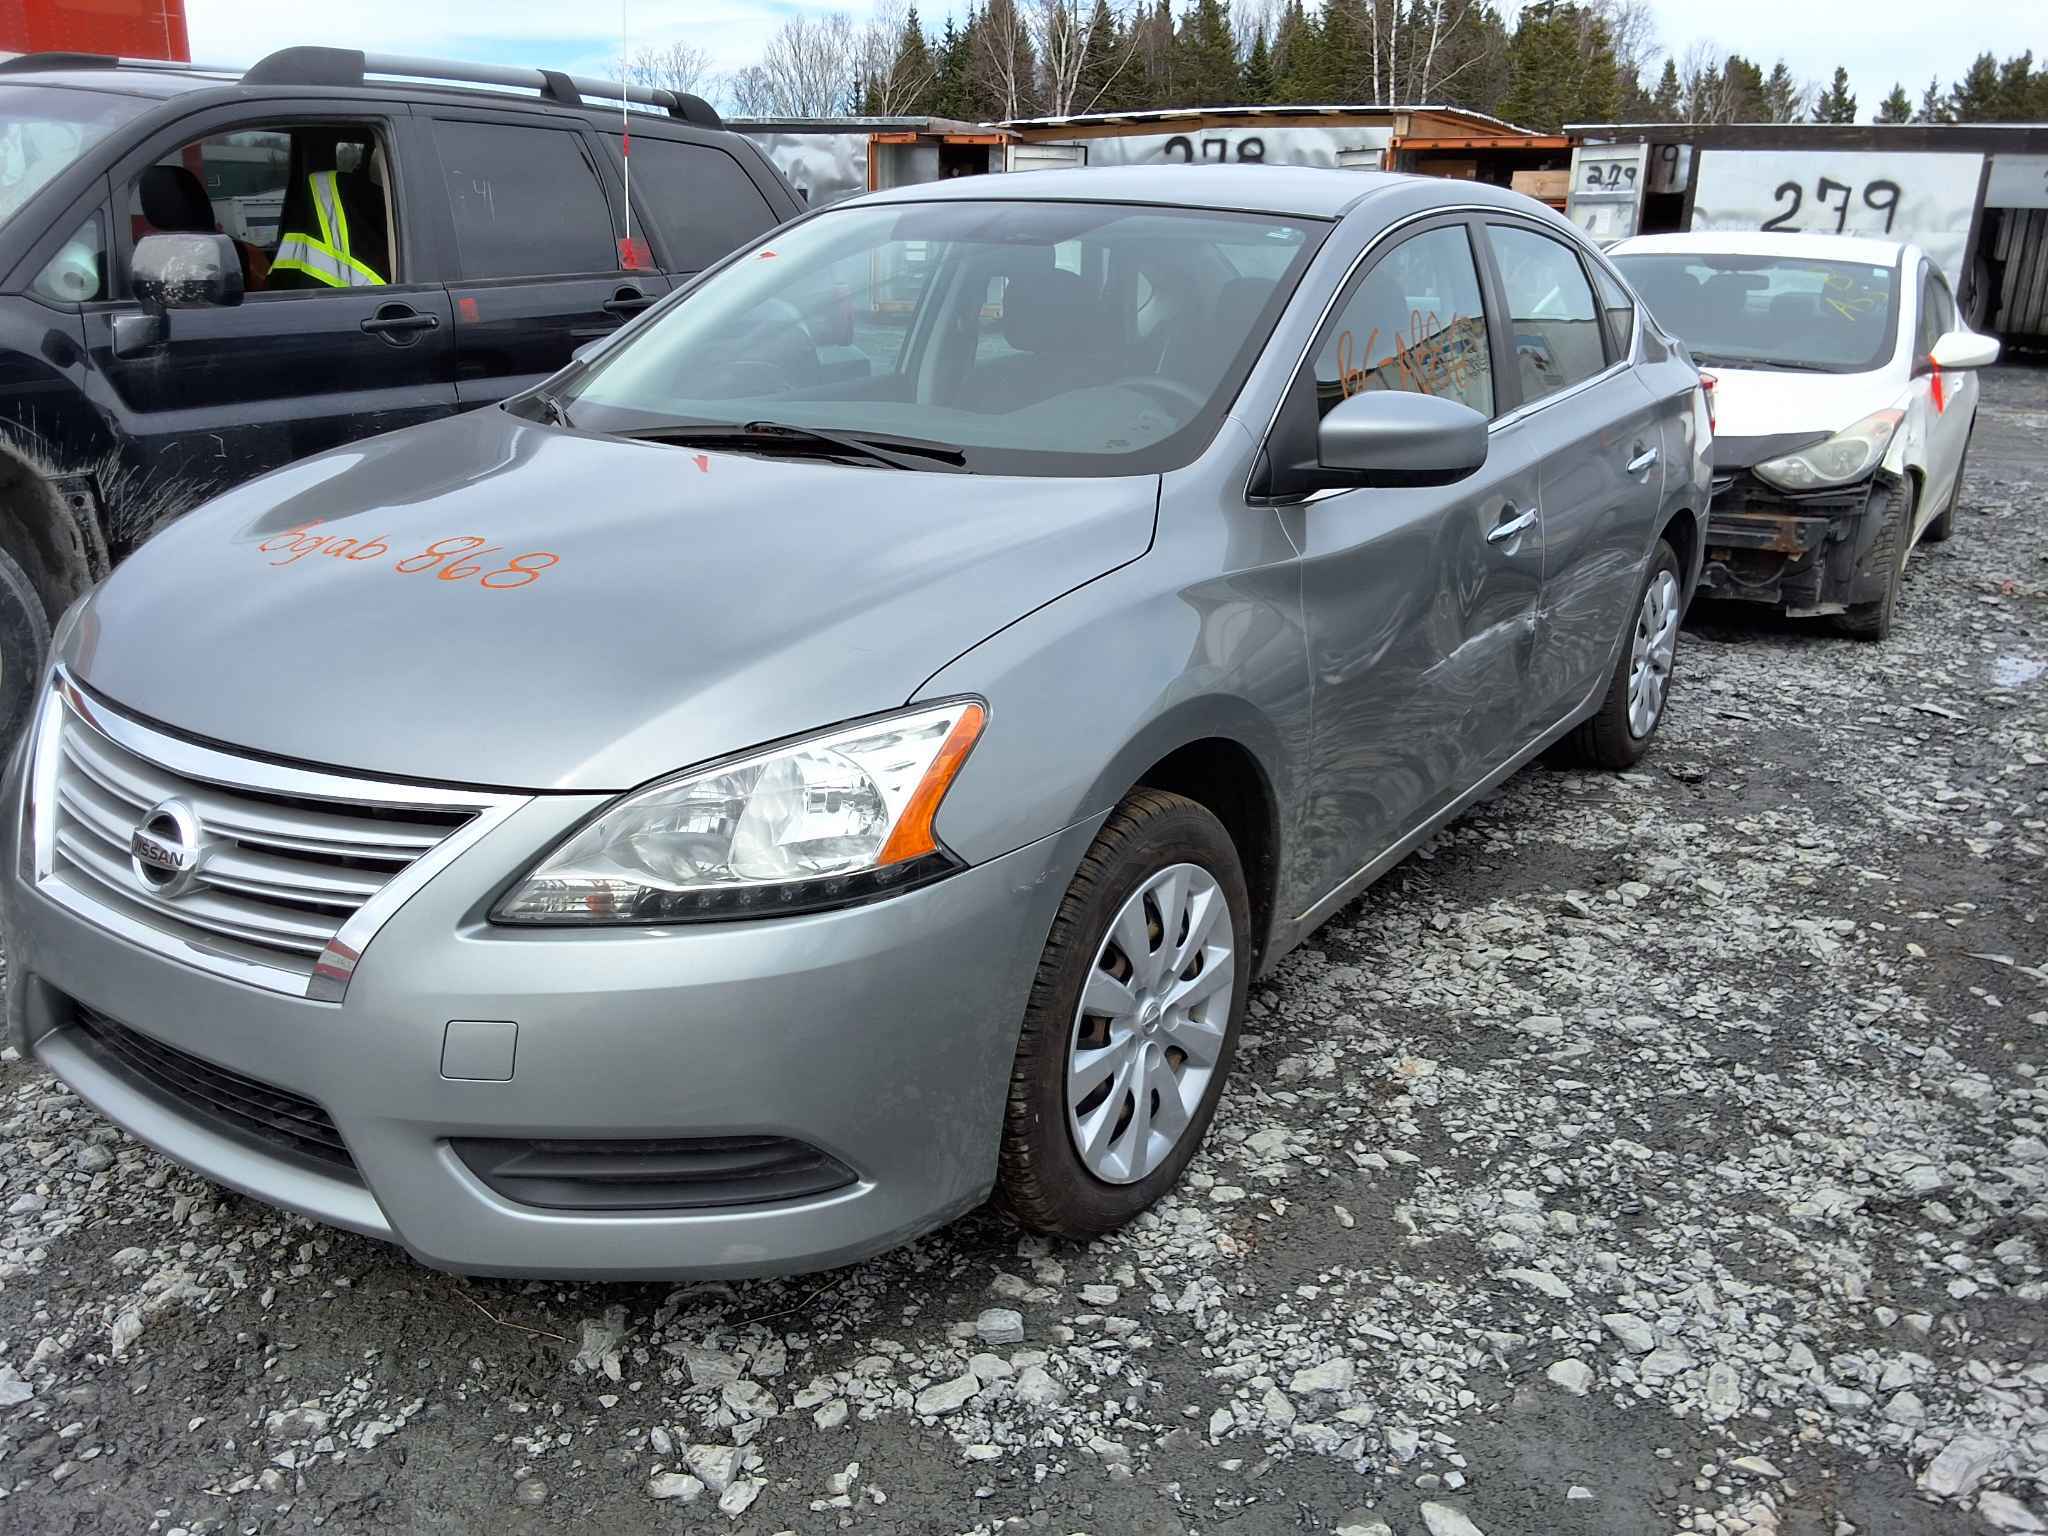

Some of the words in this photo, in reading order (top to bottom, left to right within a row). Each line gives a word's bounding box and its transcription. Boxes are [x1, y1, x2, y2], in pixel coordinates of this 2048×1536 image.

[1586, 163, 1638, 191] 279
[1760, 177, 1902, 235] 279
[395, 536, 560, 589] 868
[131, 838, 185, 867] NISSAN
